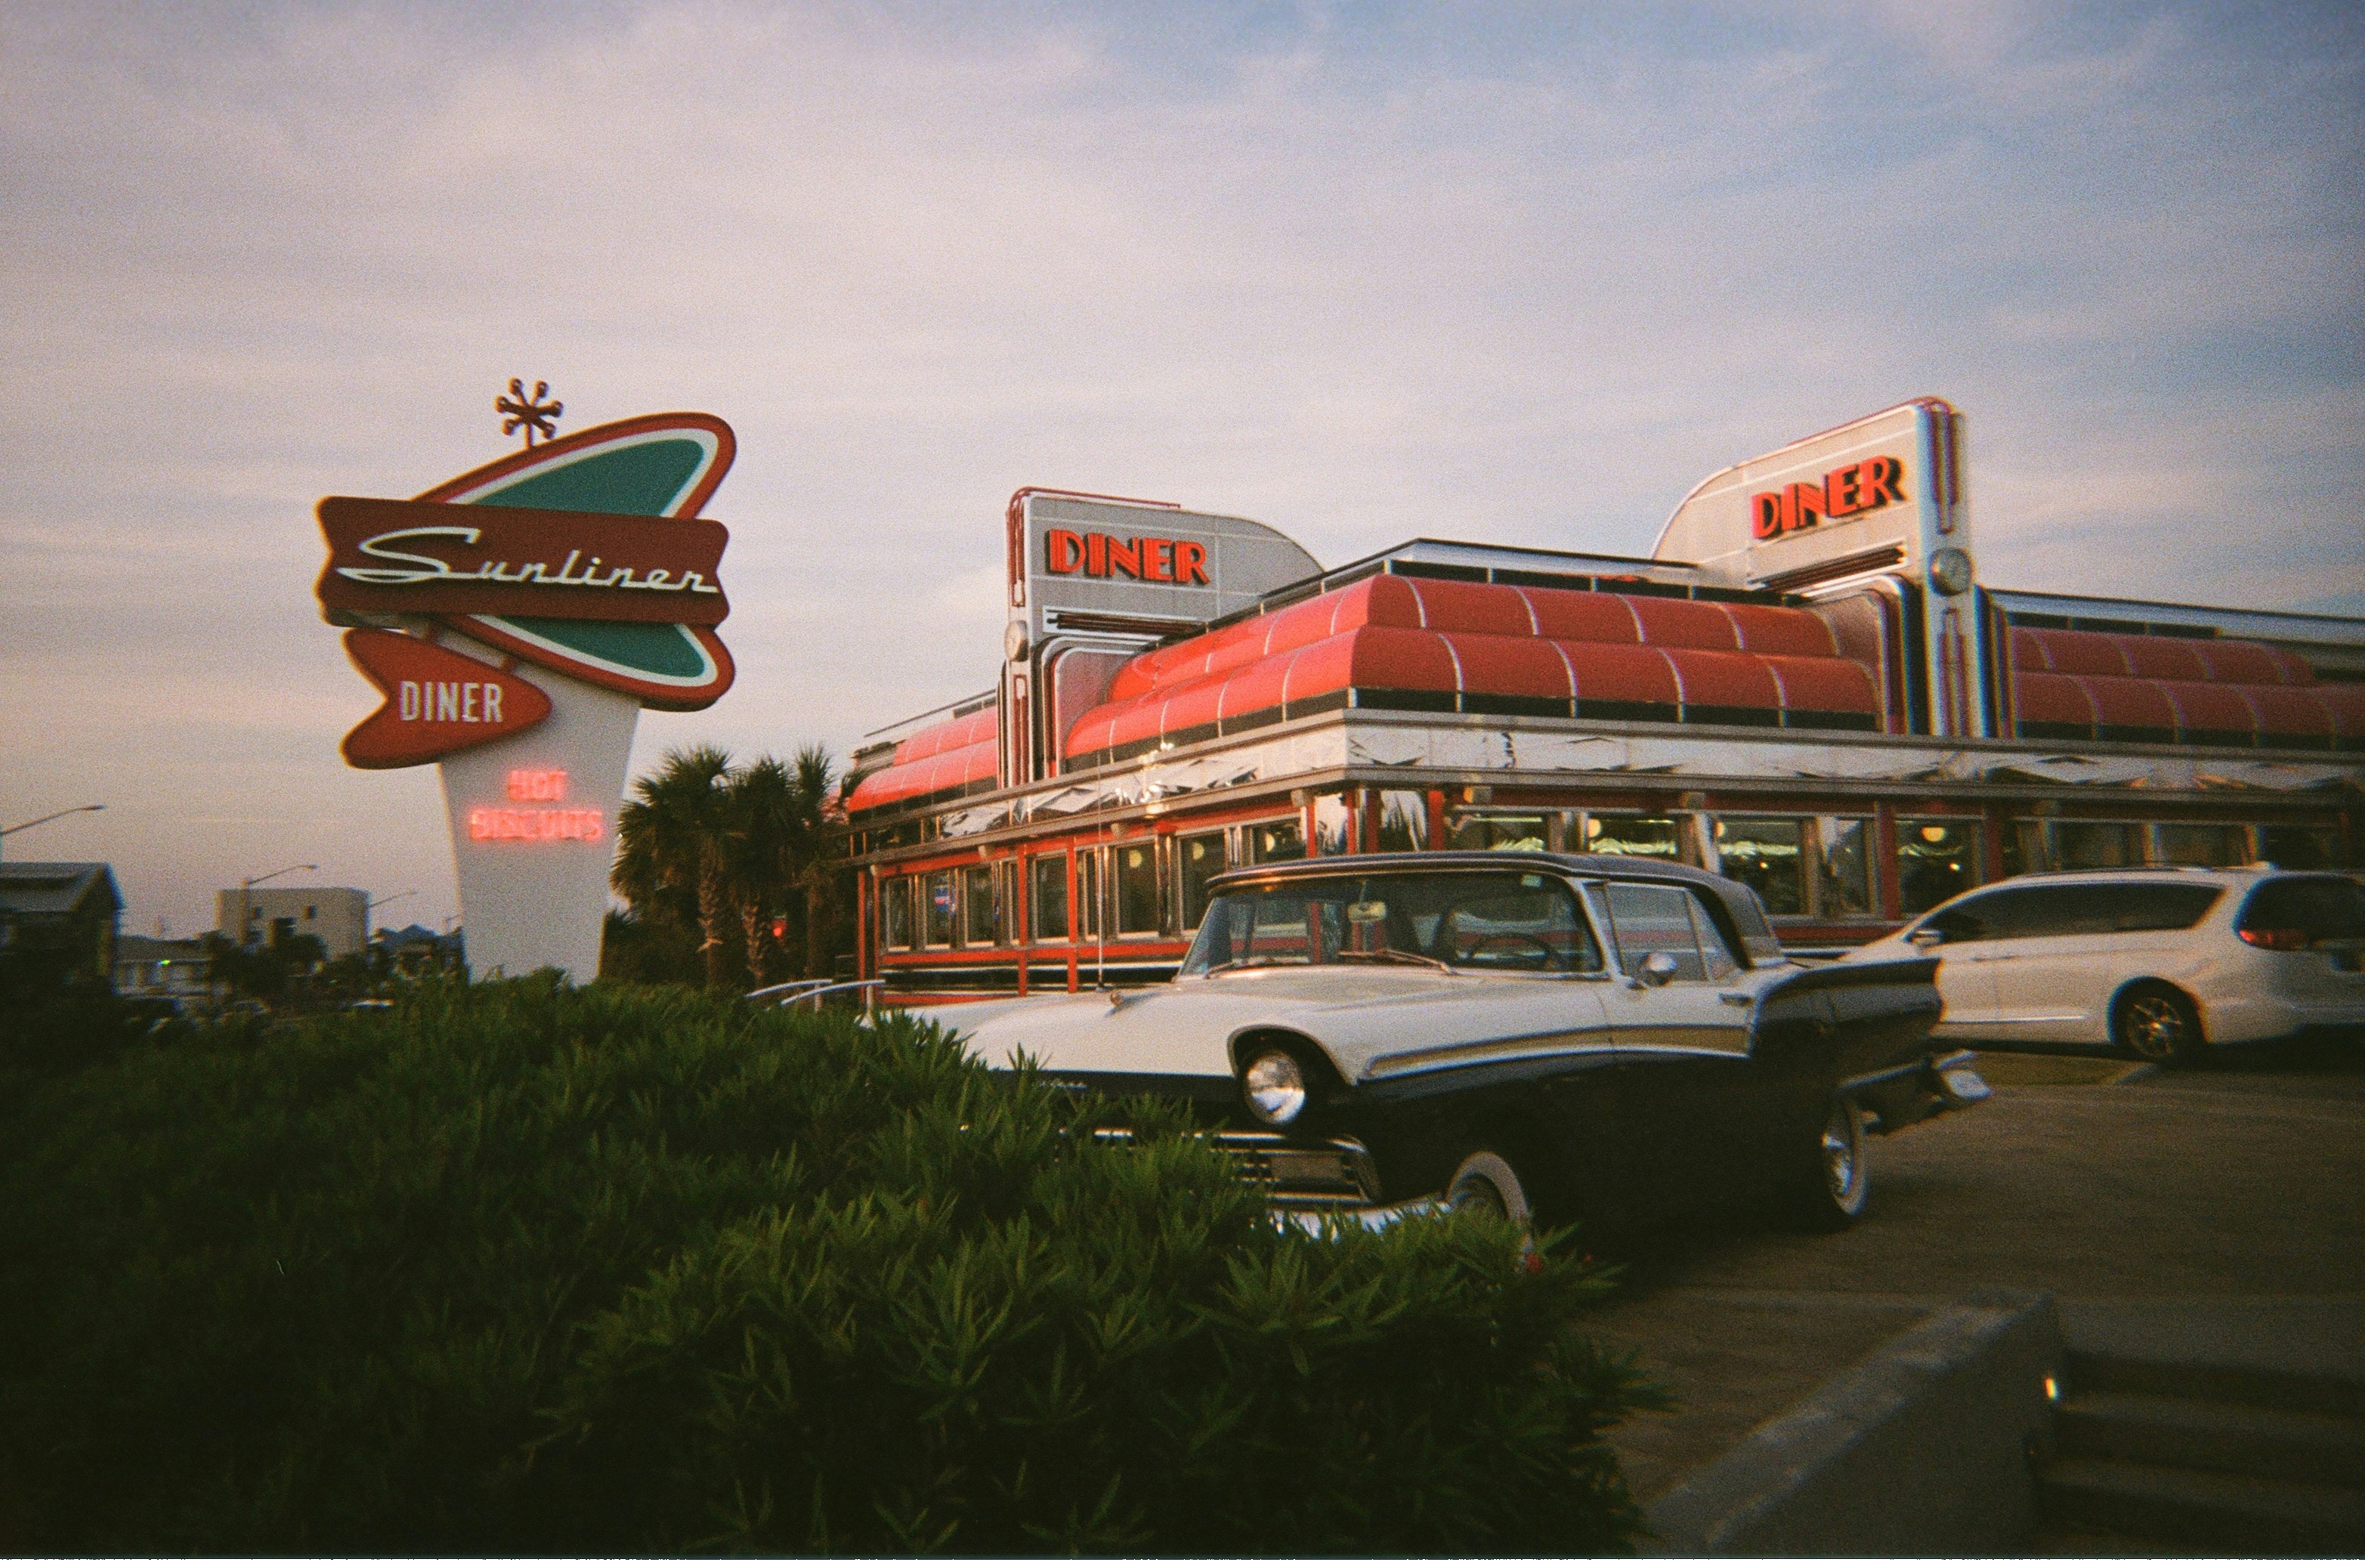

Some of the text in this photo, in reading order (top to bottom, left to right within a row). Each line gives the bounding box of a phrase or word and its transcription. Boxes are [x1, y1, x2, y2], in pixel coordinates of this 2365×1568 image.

[1750, 455, 1897, 539] DINER
[335, 527, 719, 593] Sunliner
[1047, 529, 1210, 584] DINER
[400, 681, 503, 722] DINER
[508, 771, 567, 801] HOT
